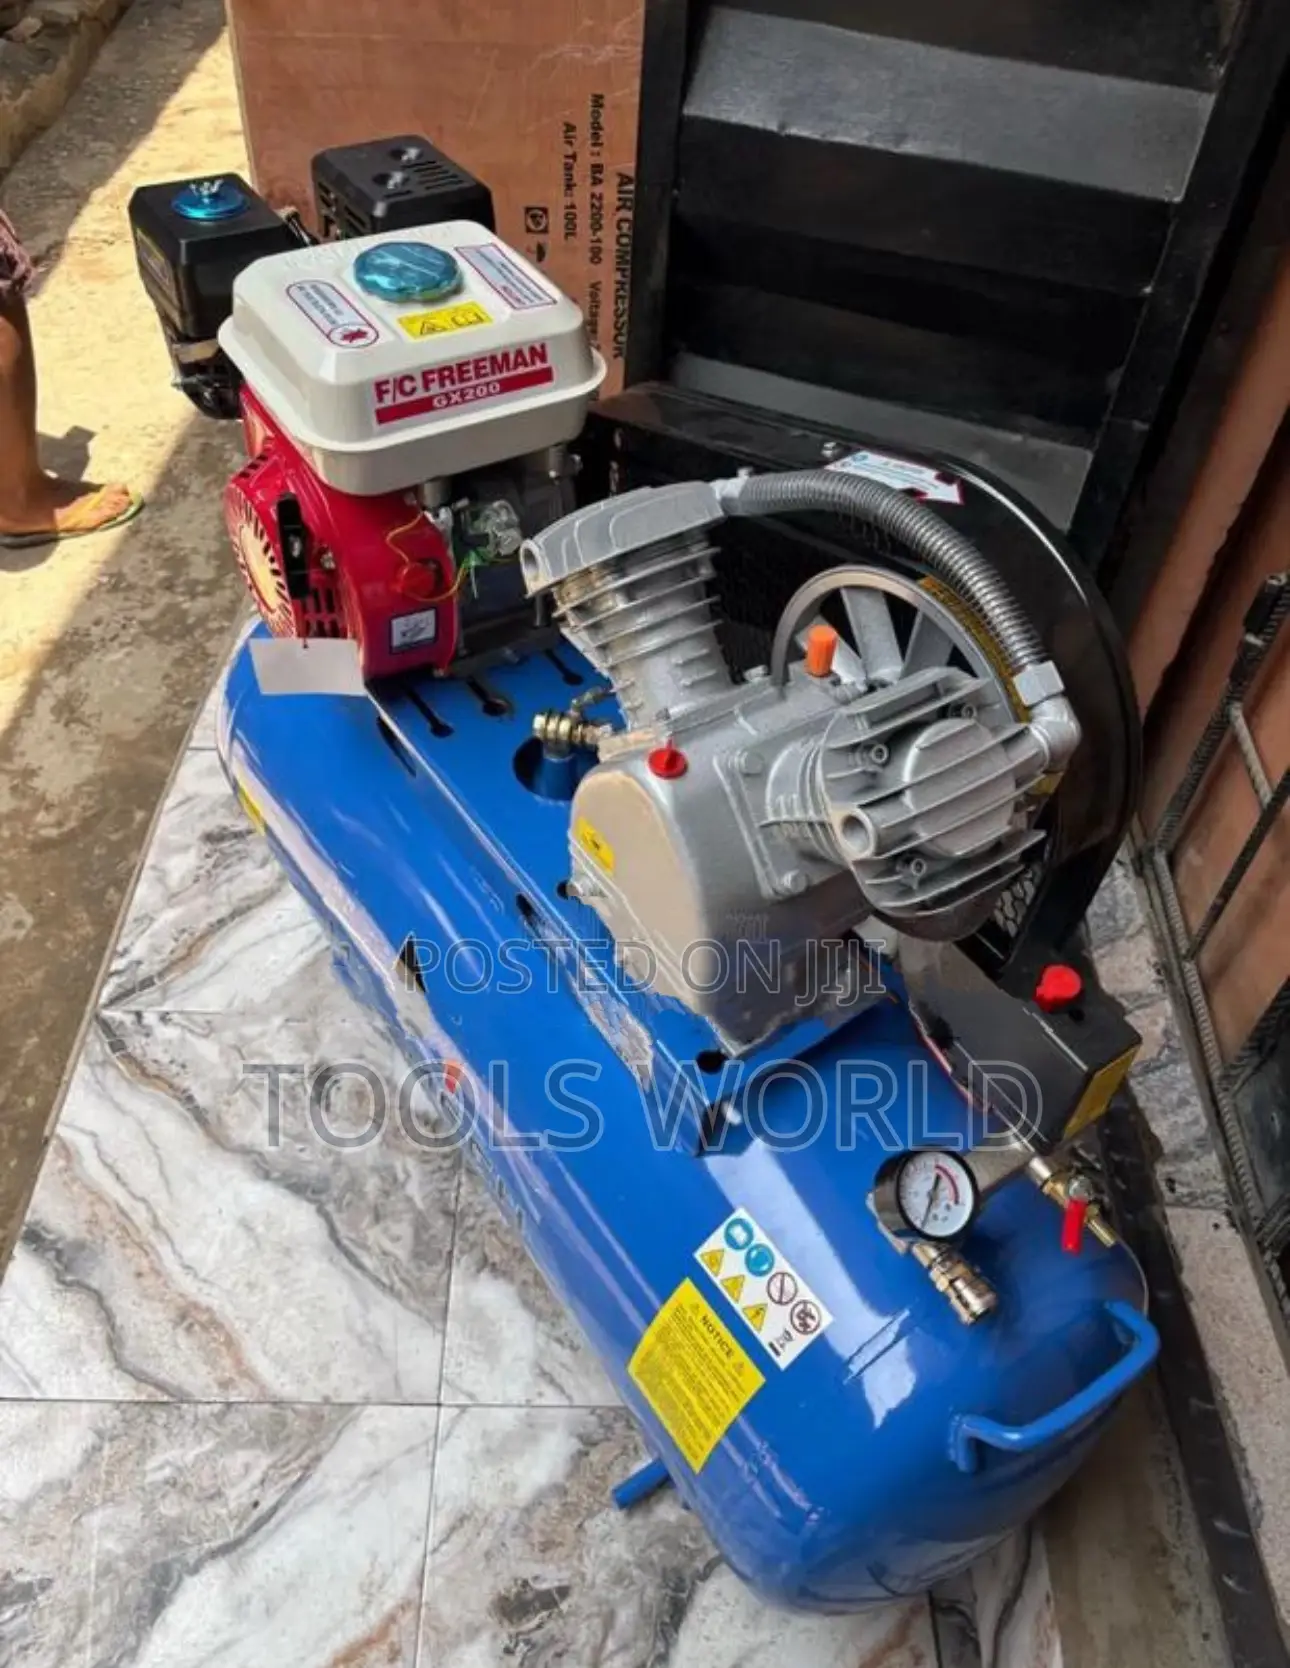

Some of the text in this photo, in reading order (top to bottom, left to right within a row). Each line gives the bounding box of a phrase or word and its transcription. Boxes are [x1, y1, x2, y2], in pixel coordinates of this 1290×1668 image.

[590, 93, 605, 148] Model
[563, 122, 577, 241] Air Tank: 100L
[590, 163, 604, 186] BA
[588, 192, 604, 266] 2200-100
[613, 172, 634, 359] AIR COMPRESSOR
[374, 342, 548, 403] F/C FREEMAN
[432, 381, 501, 408] GX200
[701, 1314, 734, 1358] NOTICE
